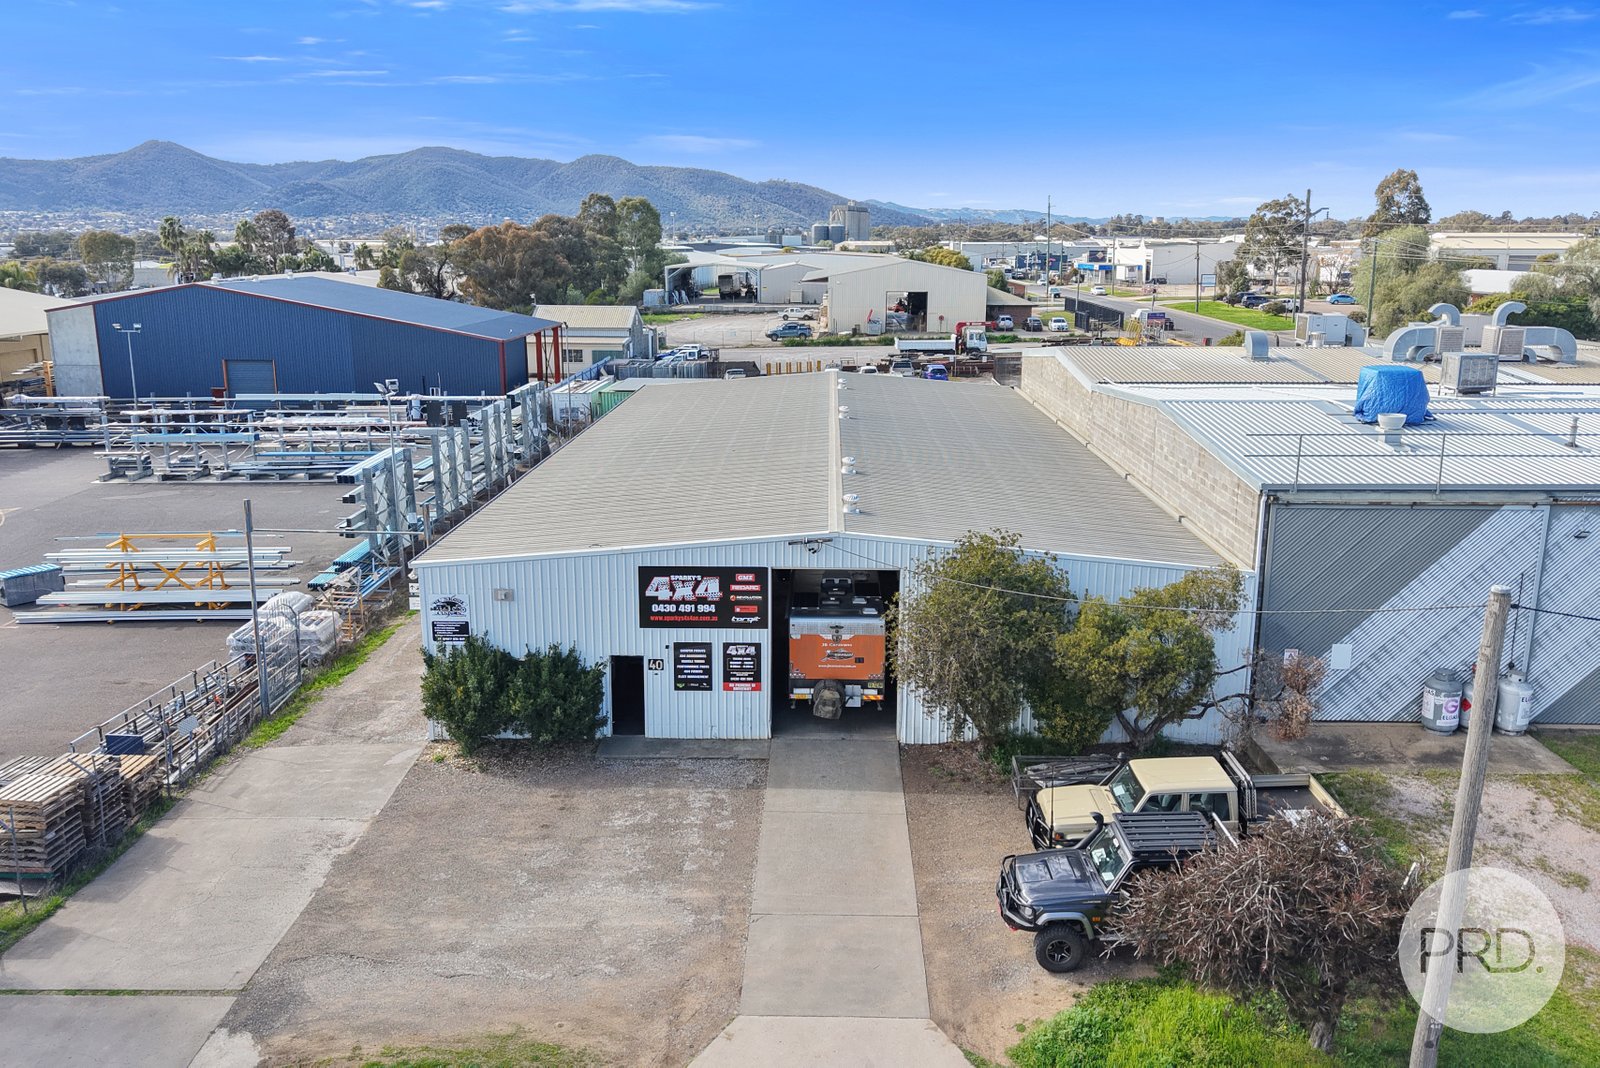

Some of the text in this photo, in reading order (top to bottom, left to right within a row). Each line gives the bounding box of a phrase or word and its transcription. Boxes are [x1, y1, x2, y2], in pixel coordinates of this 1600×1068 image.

[651, 604, 716, 613] 0430 491 994
[649, 659, 663, 670] 40
